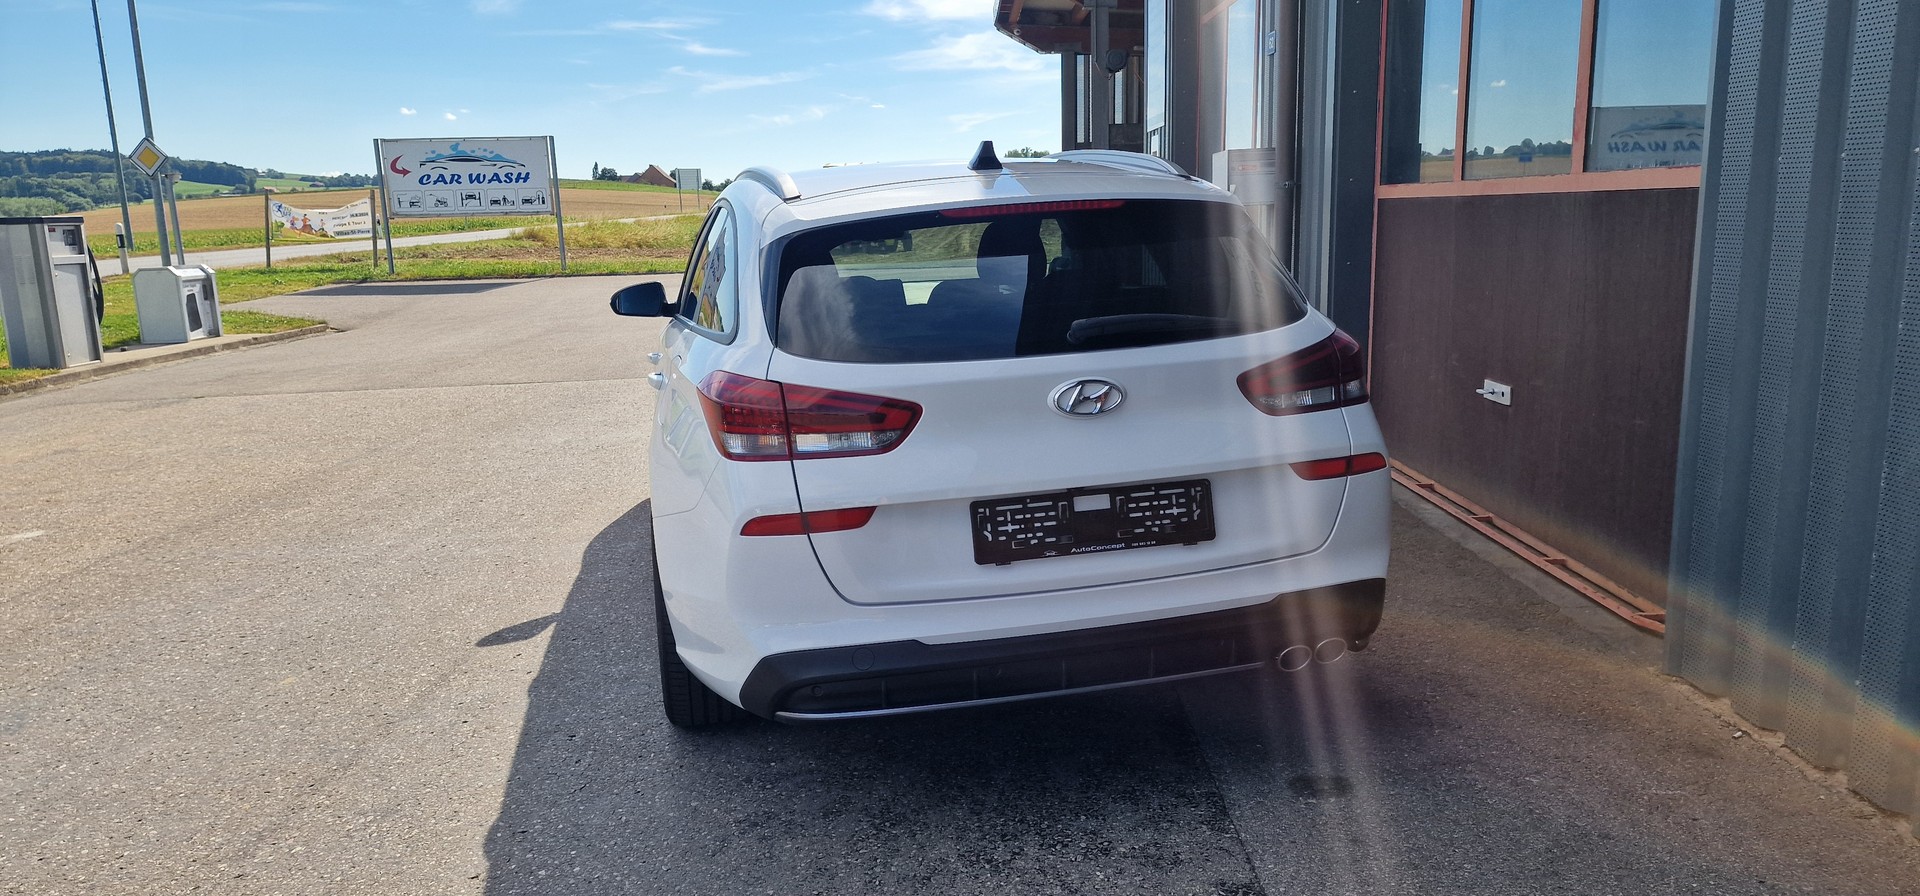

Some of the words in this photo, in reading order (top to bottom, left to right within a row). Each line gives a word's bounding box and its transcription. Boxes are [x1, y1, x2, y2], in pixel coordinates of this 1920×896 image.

[418, 173, 462, 185] CAR
[468, 171, 530, 184] WASH
[1070, 542, 1126, 554] AutoConcept
